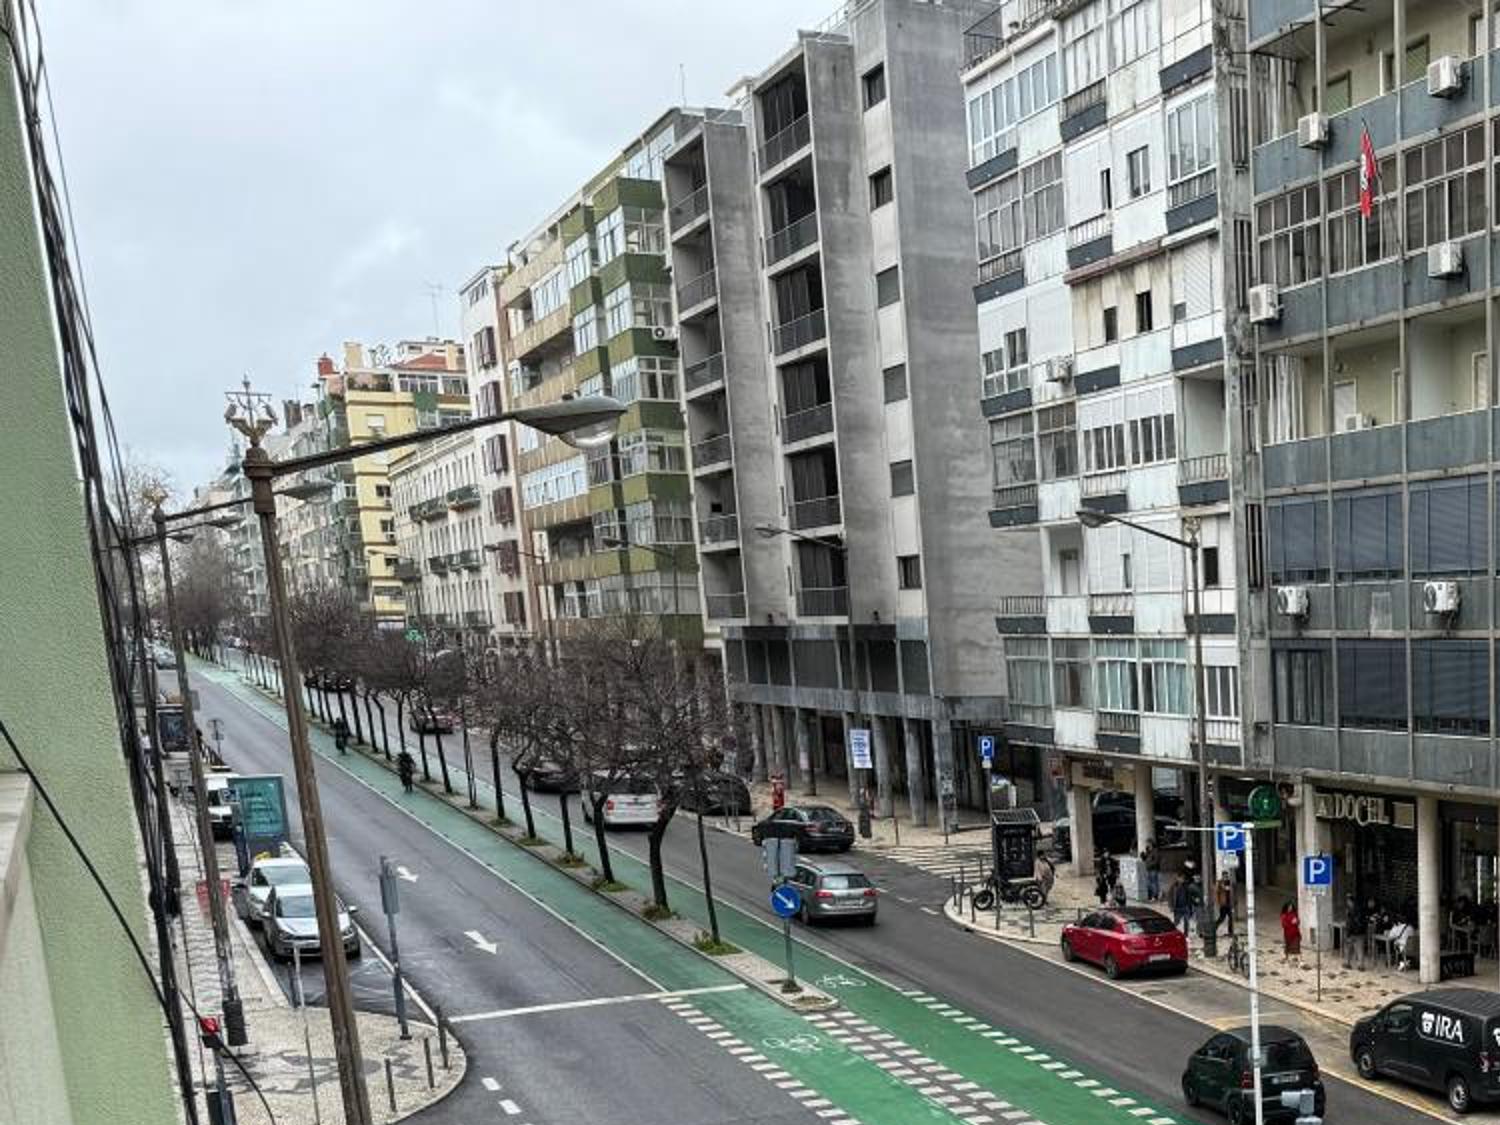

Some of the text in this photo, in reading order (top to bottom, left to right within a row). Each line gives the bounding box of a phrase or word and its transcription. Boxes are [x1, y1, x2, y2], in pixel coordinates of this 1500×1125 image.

[981, 738, 991, 753] P
[1222, 825, 1239, 849] P
[1309, 859, 1326, 883] P
[1435, 1014, 1464, 1043] IRA
